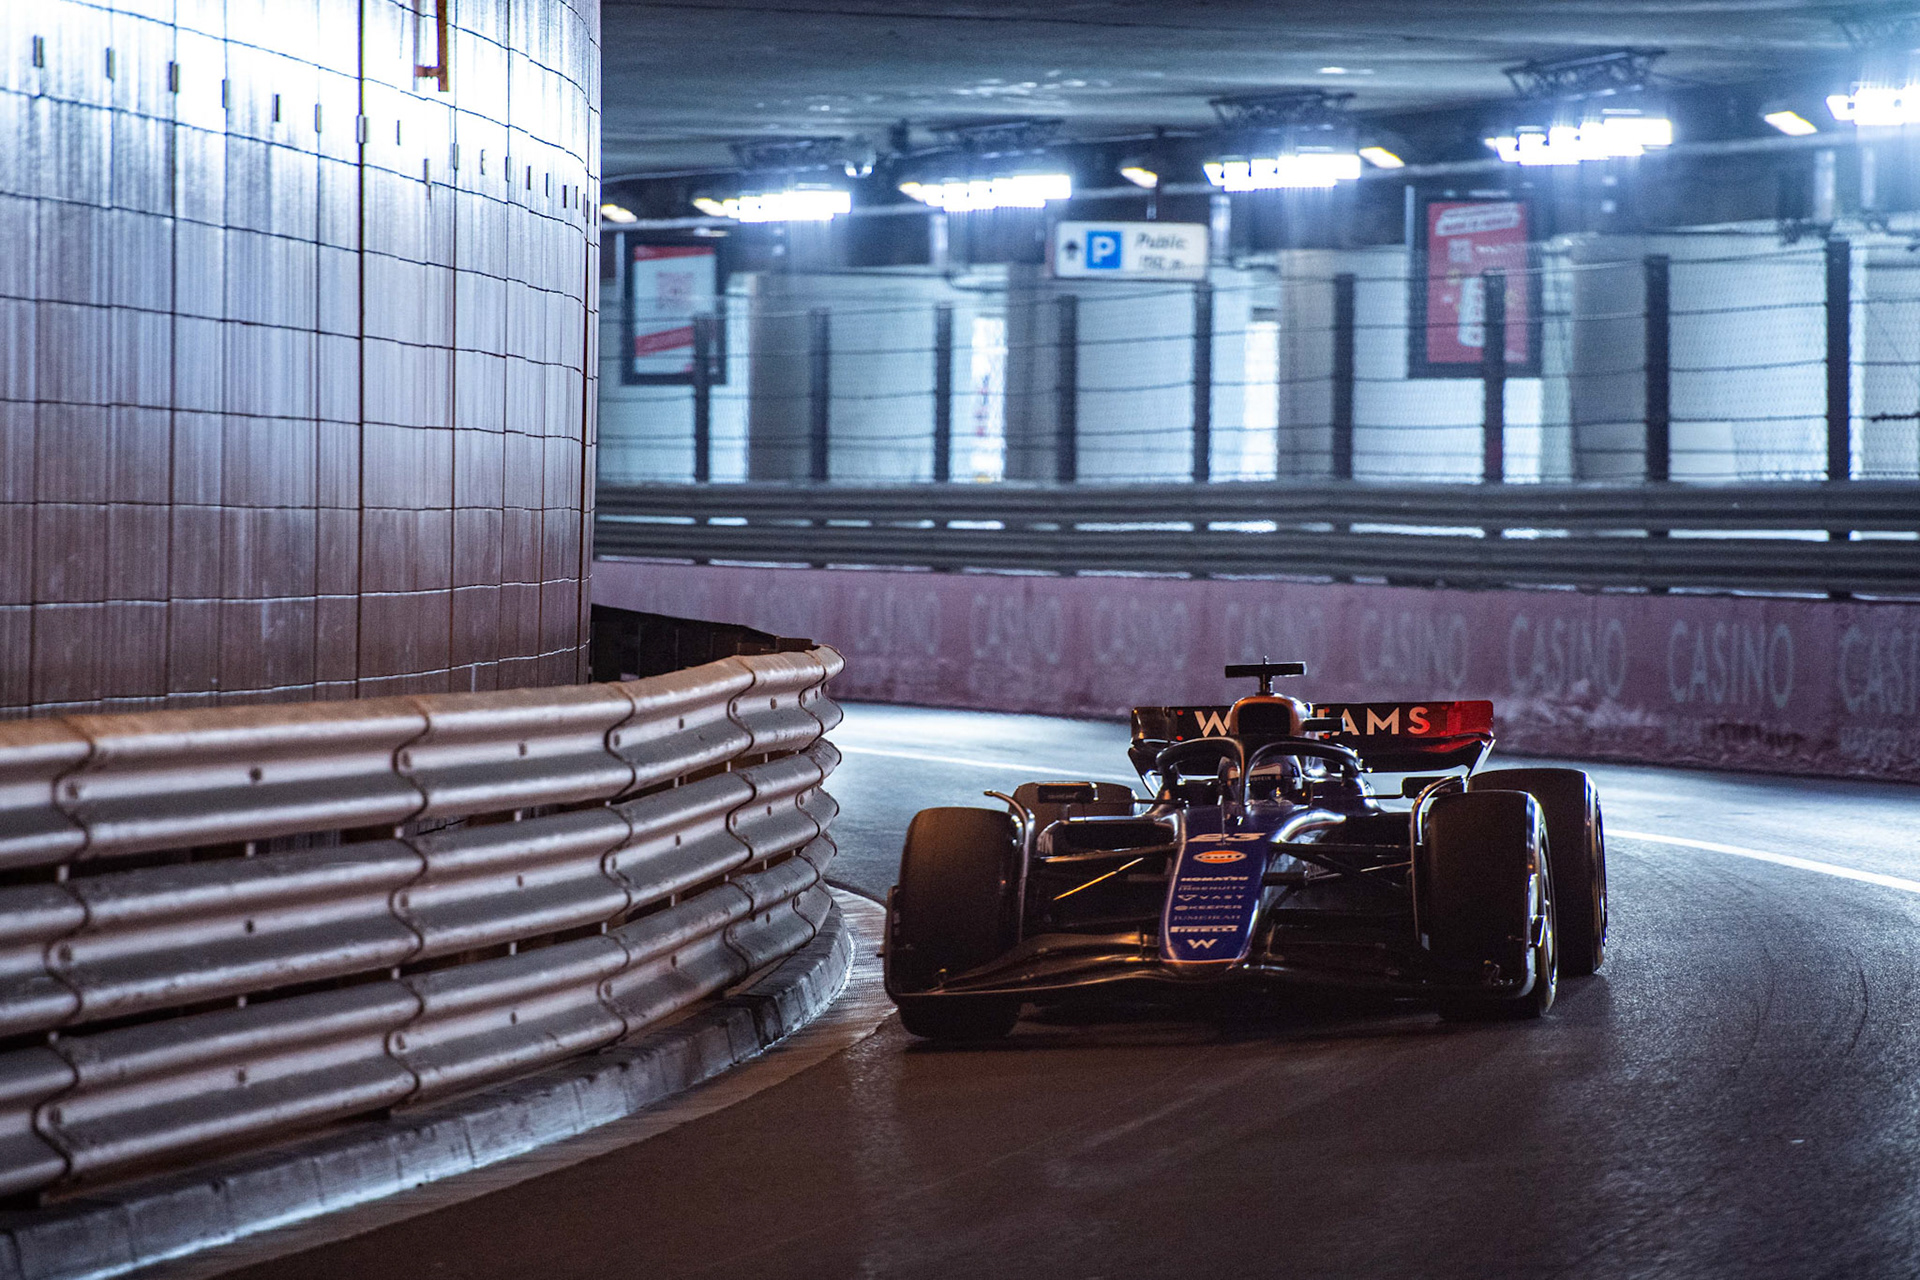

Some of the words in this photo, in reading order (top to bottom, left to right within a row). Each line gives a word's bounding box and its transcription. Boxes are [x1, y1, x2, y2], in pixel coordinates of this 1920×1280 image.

[1093, 236, 1116, 263] P
[1360, 608, 1468, 690] CASINO
[1508, 613, 1627, 700] CASINO
[1667, 618, 1795, 709] CASINO
[1838, 625, 1920, 714] CASI
[1187, 831, 1266, 842] 23
[1169, 925, 1239, 933] PIRELLI
